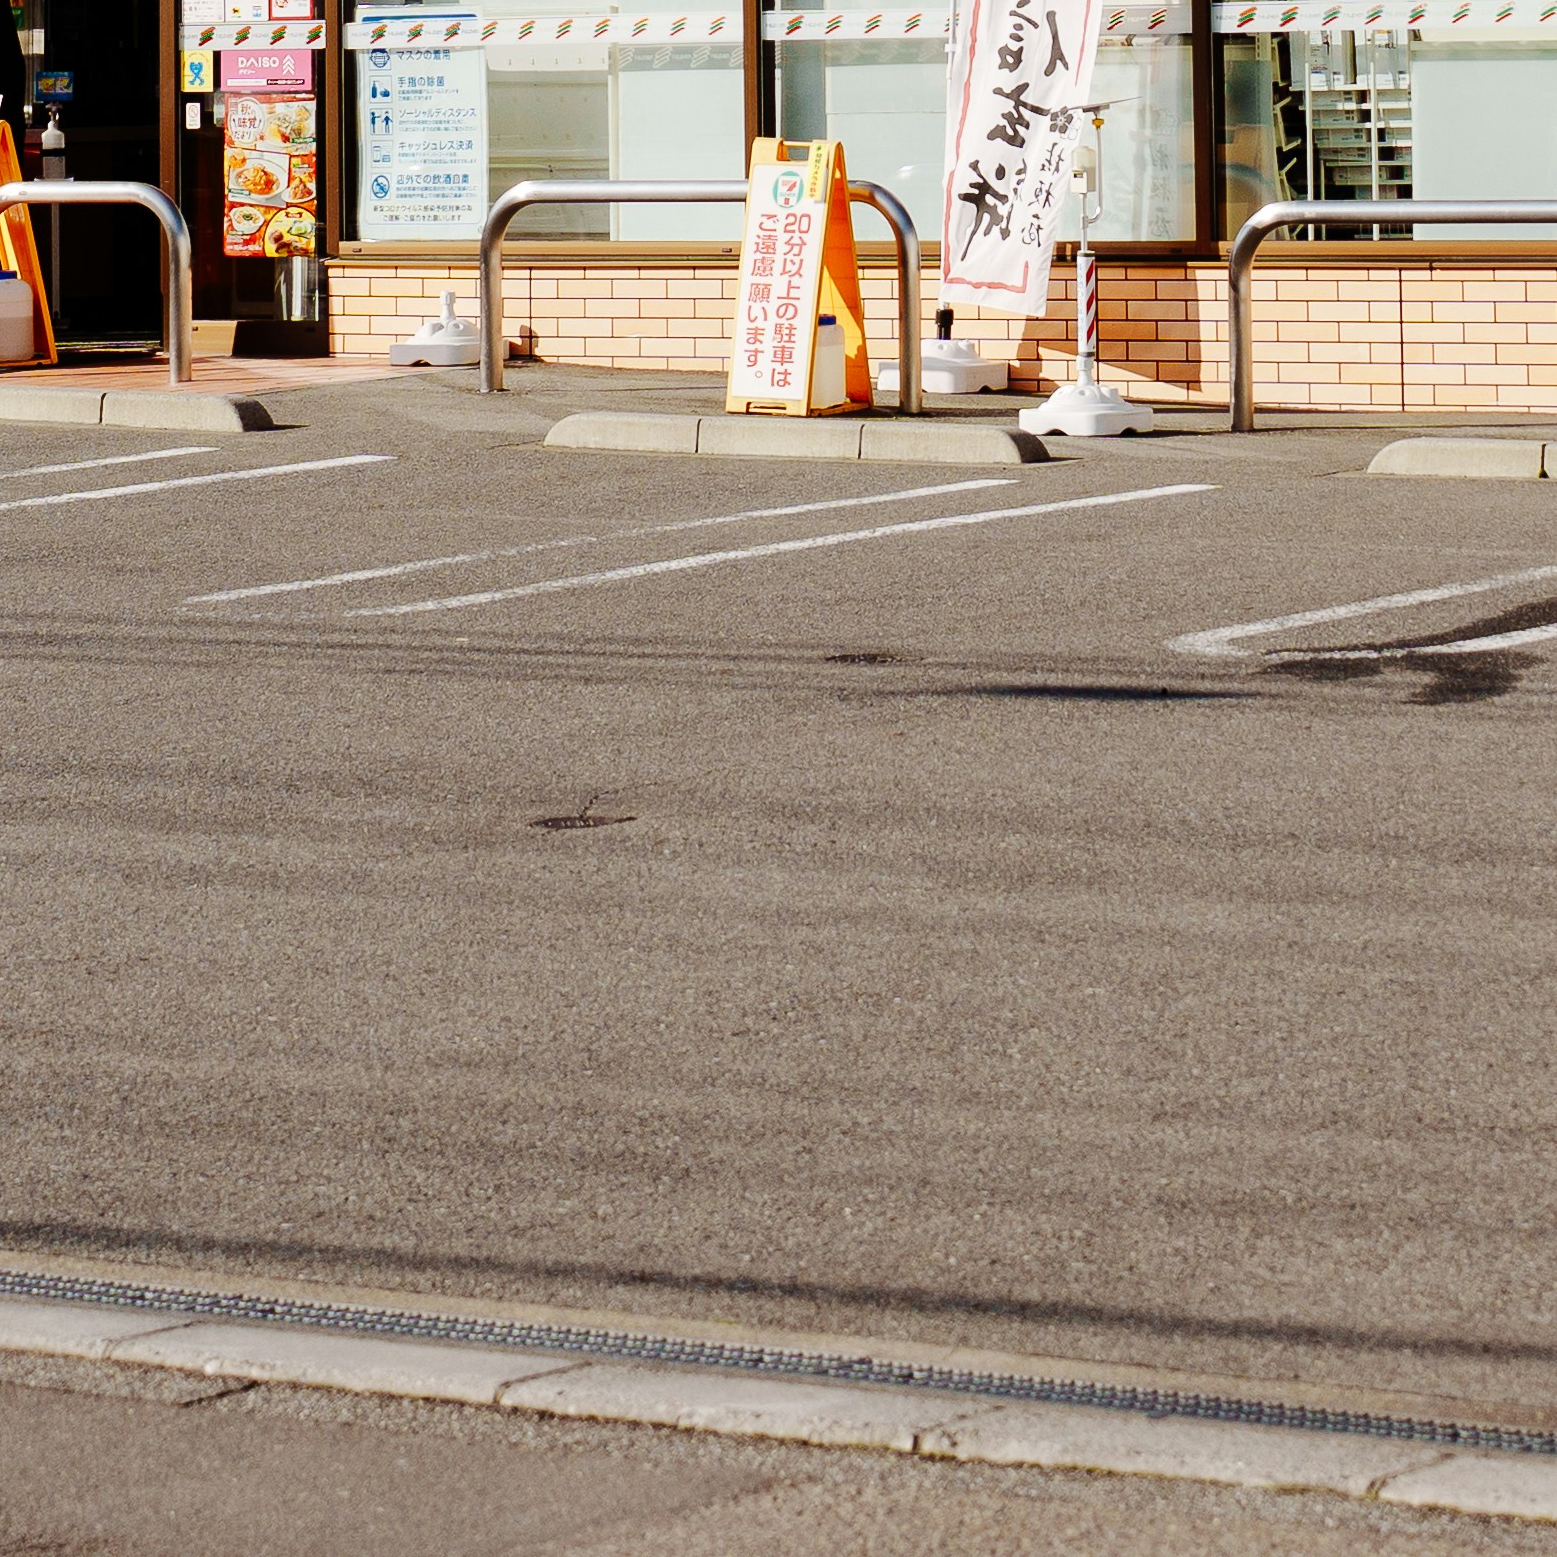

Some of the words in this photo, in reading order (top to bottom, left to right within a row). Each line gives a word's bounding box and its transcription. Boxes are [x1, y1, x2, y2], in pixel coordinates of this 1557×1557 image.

[395, 49, 451, 61] マスクの着用
[398, 108, 477, 118] ソーシャルディスタンス
[398, 140, 473, 151] キャッシュレス決済
[396, 174, 470, 185] 店外での飲酒自粛
[771, 212, 812, 388] 20分以上の駐車は
